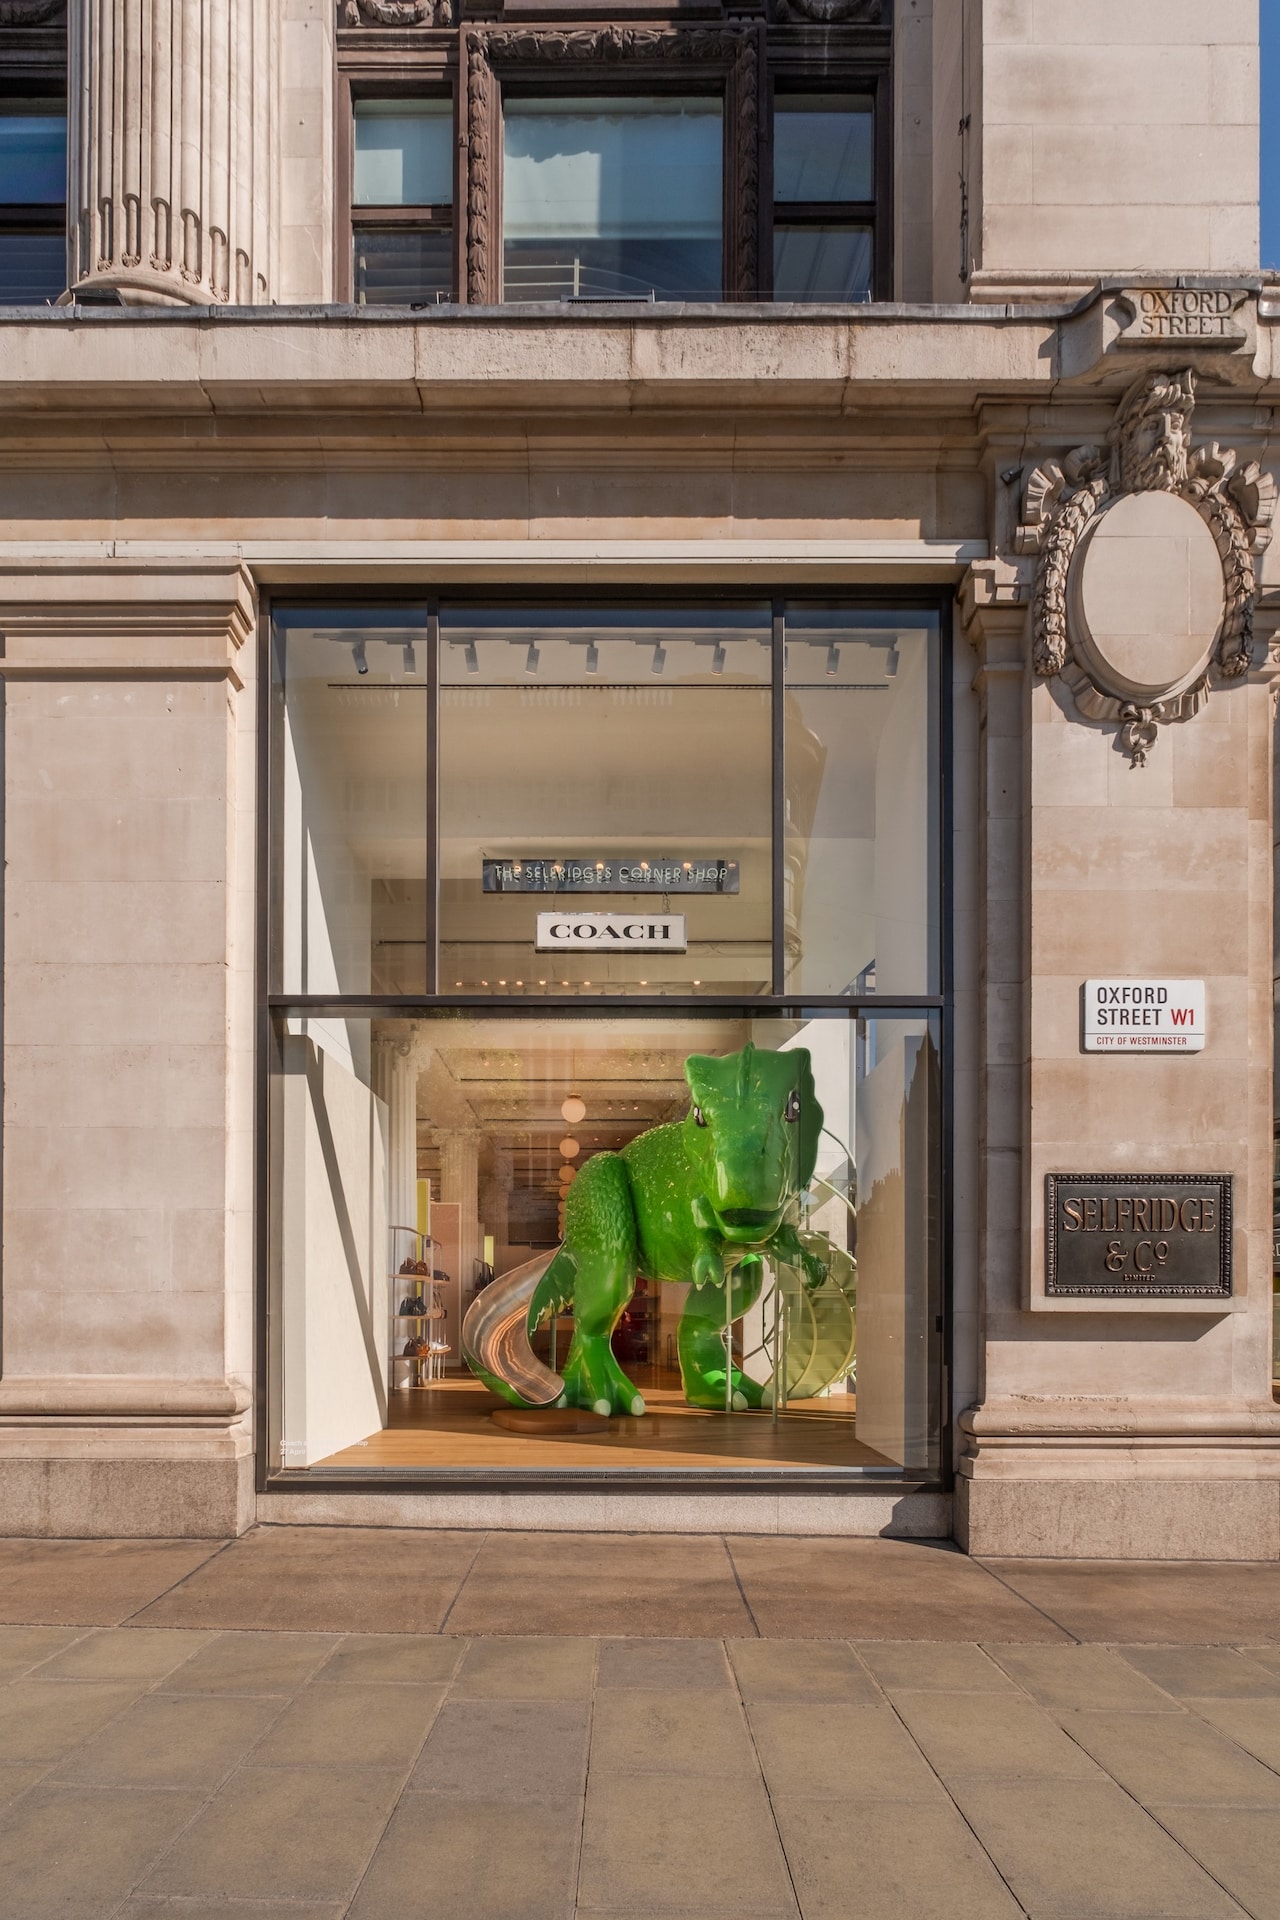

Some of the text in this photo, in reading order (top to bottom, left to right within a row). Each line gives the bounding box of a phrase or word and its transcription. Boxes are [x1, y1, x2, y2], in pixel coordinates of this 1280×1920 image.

[1140, 291, 1232, 314] OXFORD
[1141, 316, 1231, 335] STREET
[495, 865, 728, 880] THE SELFRIDGES CORNER SHOP
[549, 924, 671, 939] COACH
[1097, 987, 1168, 1004] OXFORD
[1097, 1008, 1194, 1026] STREET W1
[1096, 1036, 1187, 1045] CITY OF WESTMINSTER
[1063, 1197, 1216, 1233] SELFRIDGE
[1105, 1240, 1129, 1272] &
